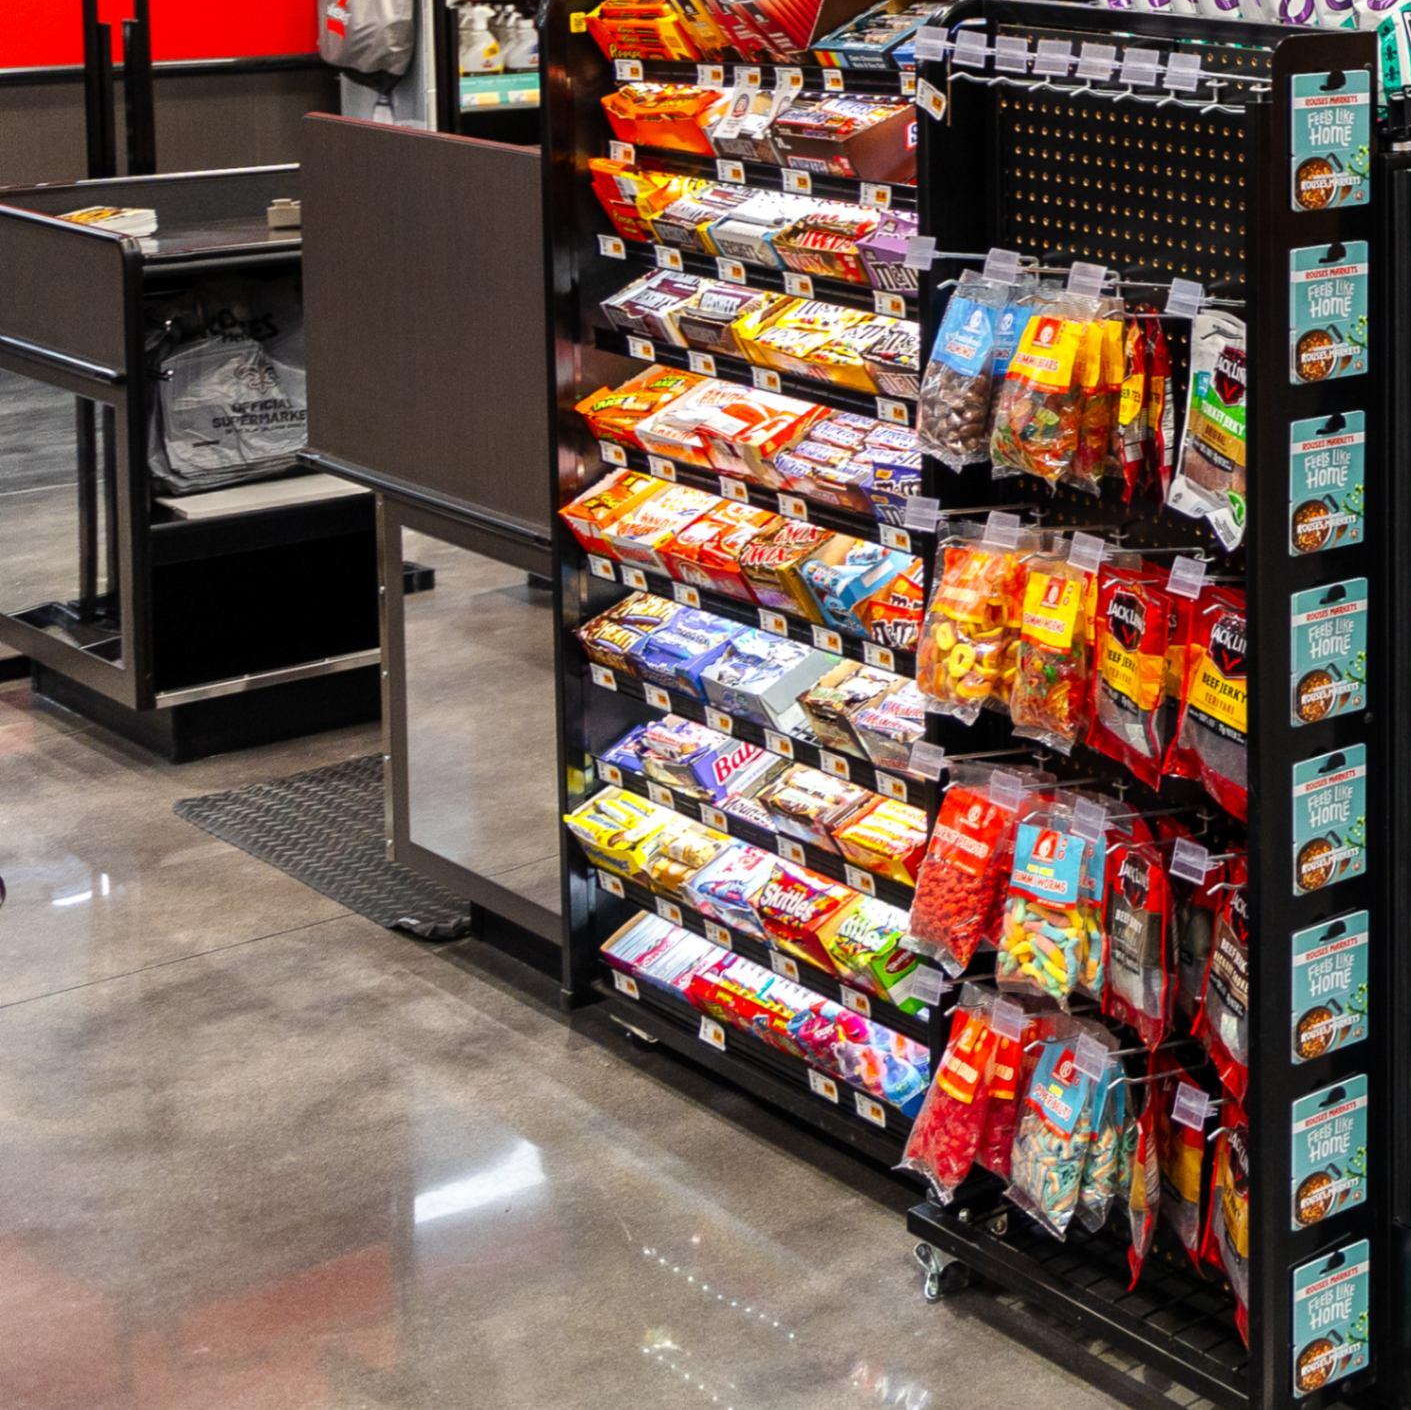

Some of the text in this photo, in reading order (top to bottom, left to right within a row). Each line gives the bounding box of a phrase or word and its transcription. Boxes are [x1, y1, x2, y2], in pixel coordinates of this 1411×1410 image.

[1307, 107, 1355, 128] FEELS LIKE
[1309, 125, 1352, 147] HOME
[212, 410, 308, 428] SUPERMARKE
[1202, 671, 1220, 689] BEEF
[1308, 785, 1354, 813] FEELS LIKE
[1310, 803, 1351, 826] HOME
[760, 883, 816, 924] Skittles
